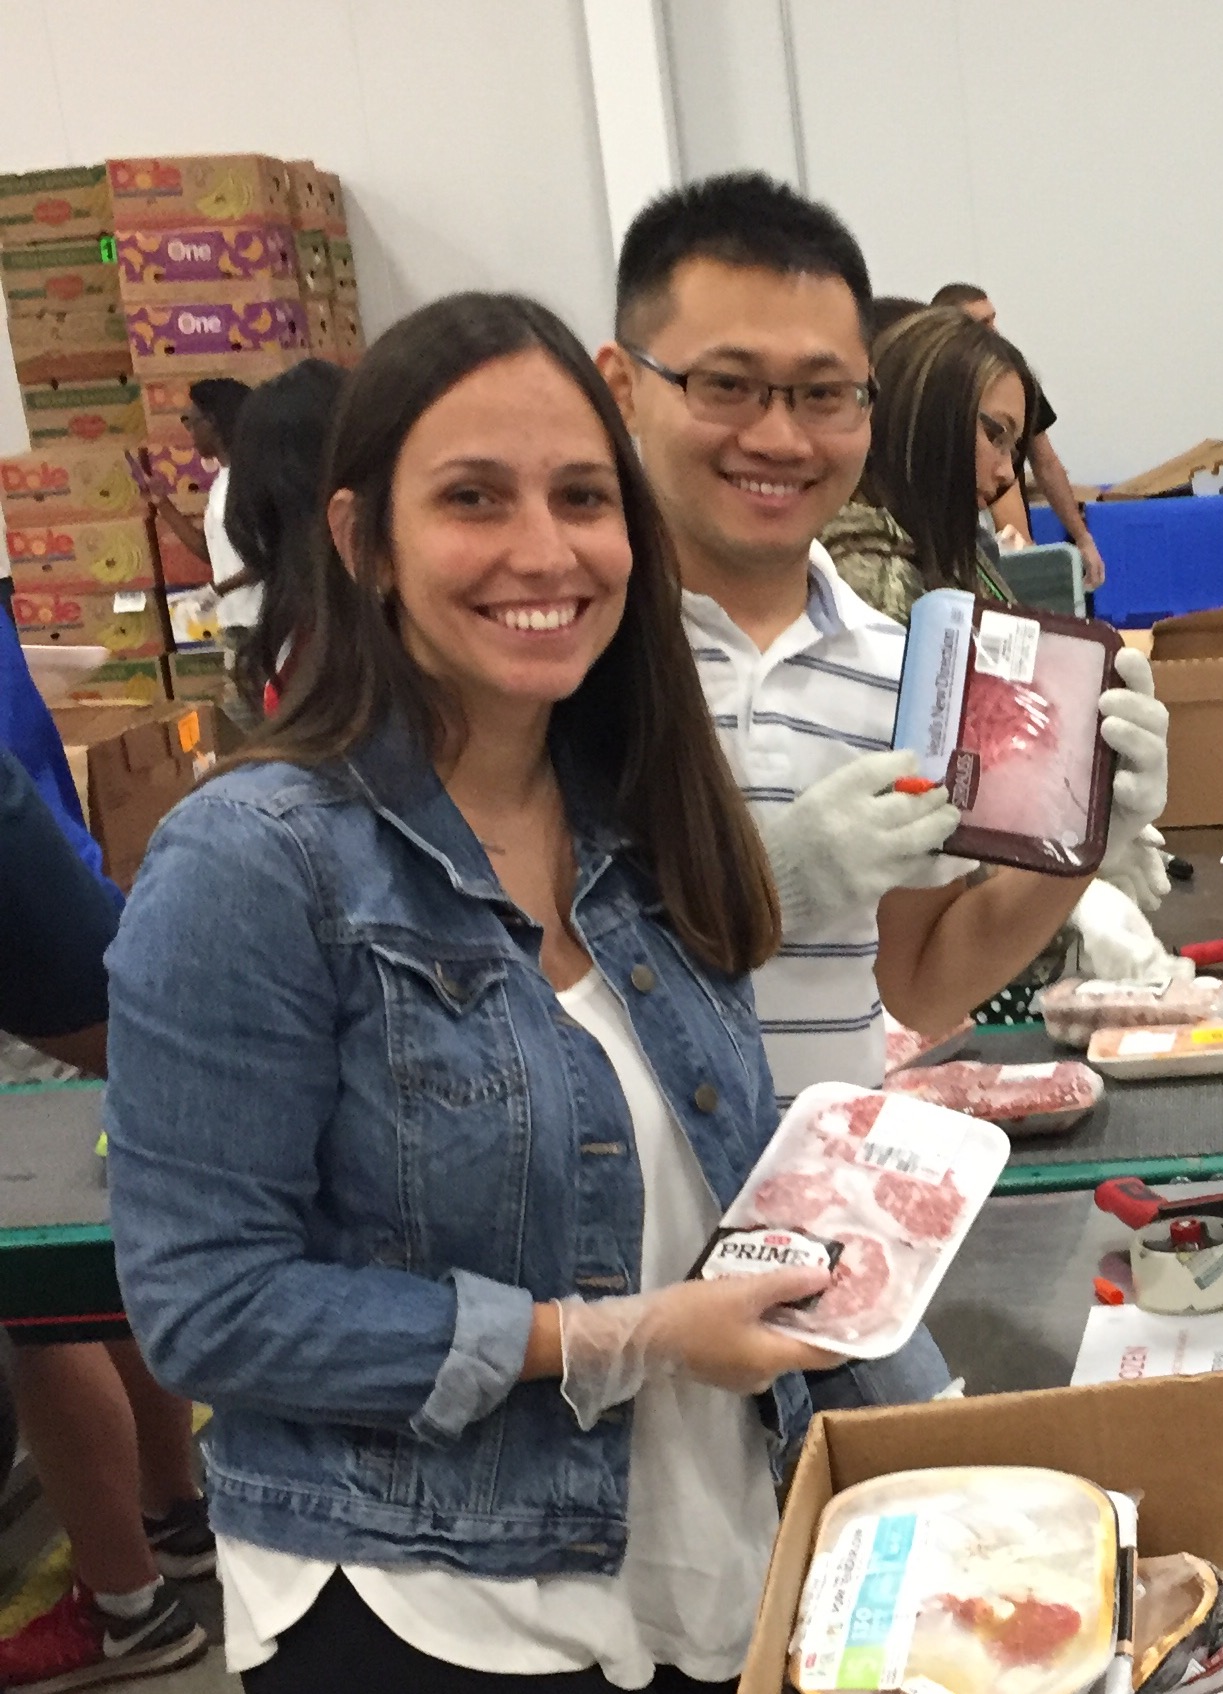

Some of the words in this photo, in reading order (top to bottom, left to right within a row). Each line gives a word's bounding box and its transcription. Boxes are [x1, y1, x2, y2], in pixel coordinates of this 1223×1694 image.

[167, 239, 212, 262] One
[178, 311, 222, 335] One
[718, 1242, 811, 1267] PRIME
